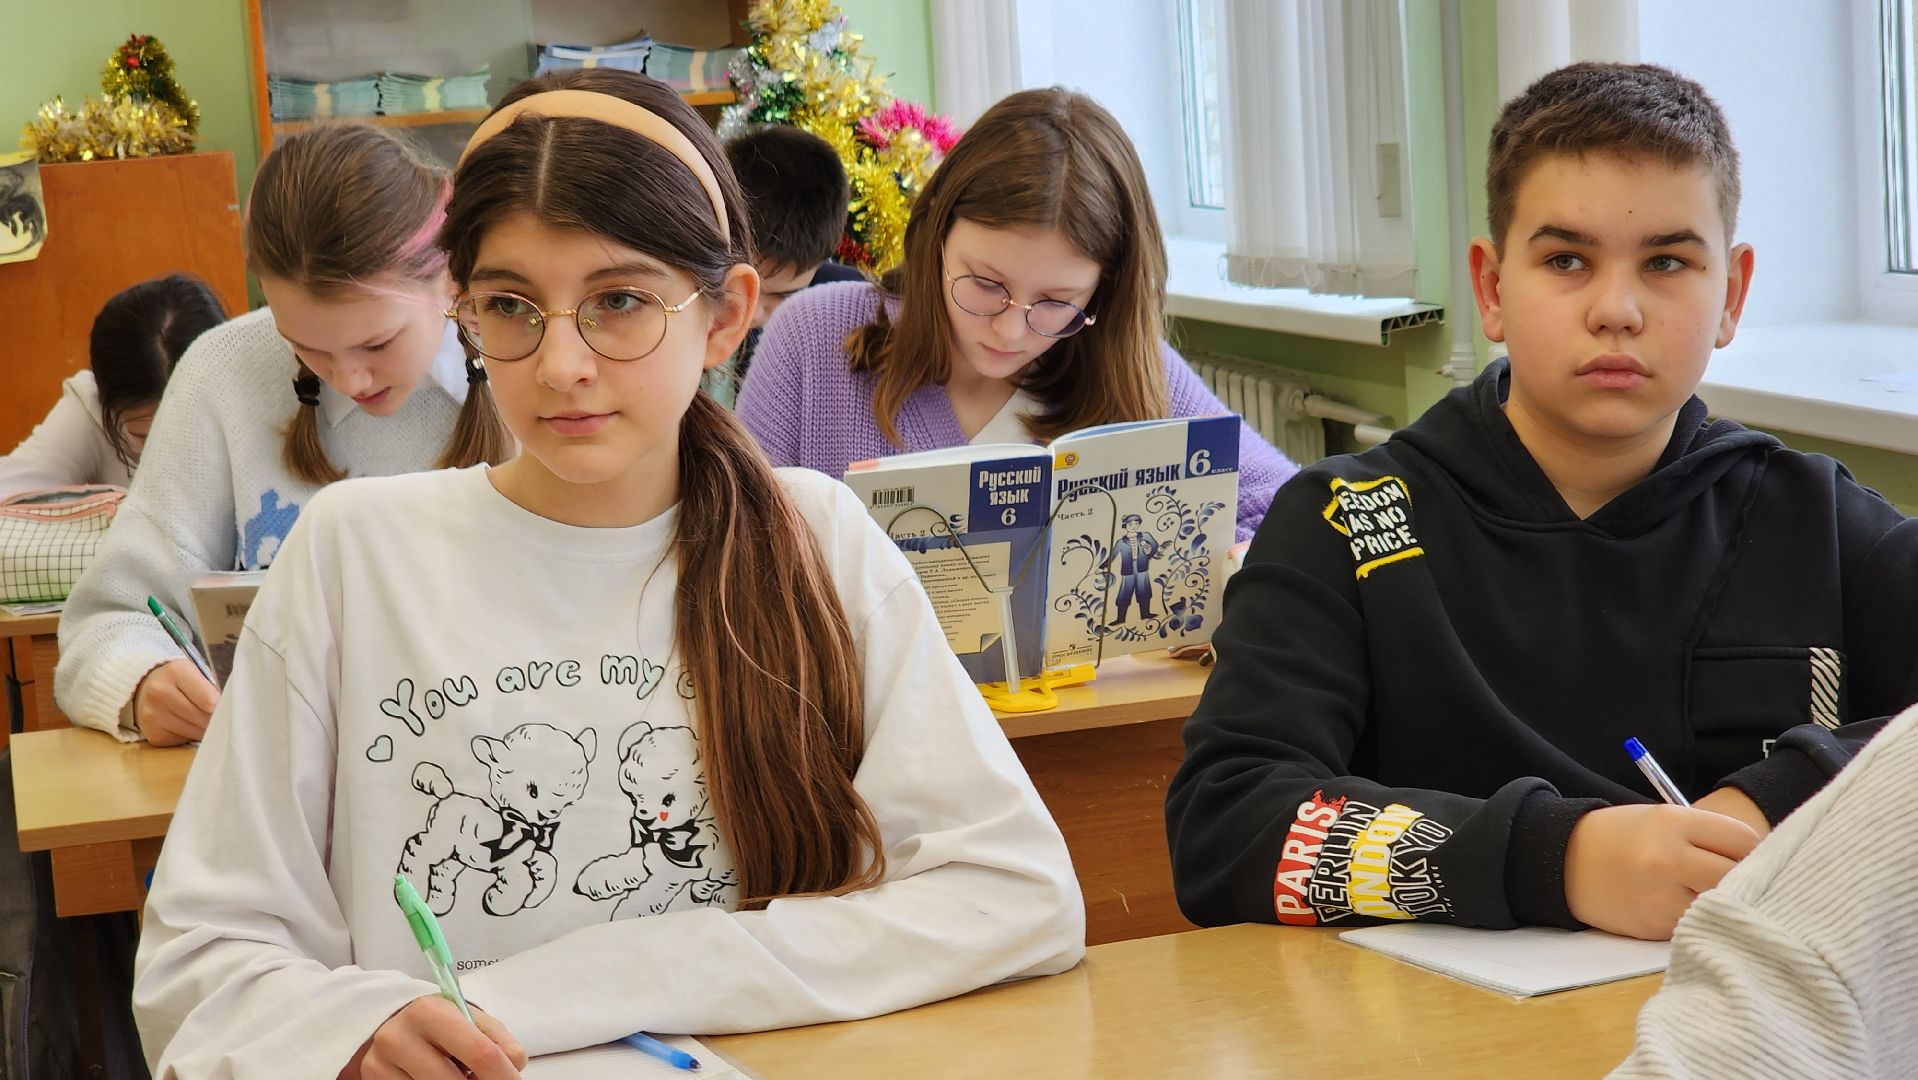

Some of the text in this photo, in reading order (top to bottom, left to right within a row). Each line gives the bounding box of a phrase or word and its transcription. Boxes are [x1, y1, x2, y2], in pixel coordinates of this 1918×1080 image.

[978, 466, 1042, 492] Русский
[1057, 467, 1129, 503] Русский
[1135, 463, 1181, 487] язык
[1188, 448, 1211, 477] 6
[989, 488, 1030, 506] язык
[1000, 507, 1017, 526] 6
[1057, 507, 1094, 521] Часть 2
[1339, 506, 1407, 538] AS NO
[919, 529, 926, 537] 2
[1350, 524, 1418, 561] PRICE
[379, 677, 479, 738] You
[496, 659, 582, 693] are
[600, 654, 665, 701] my
[1276, 801, 1339, 916] PARIS
[1351, 804, 1425, 919] ONDON
[1389, 818, 1454, 921] TOKYO
[456, 958, 500, 971] som
